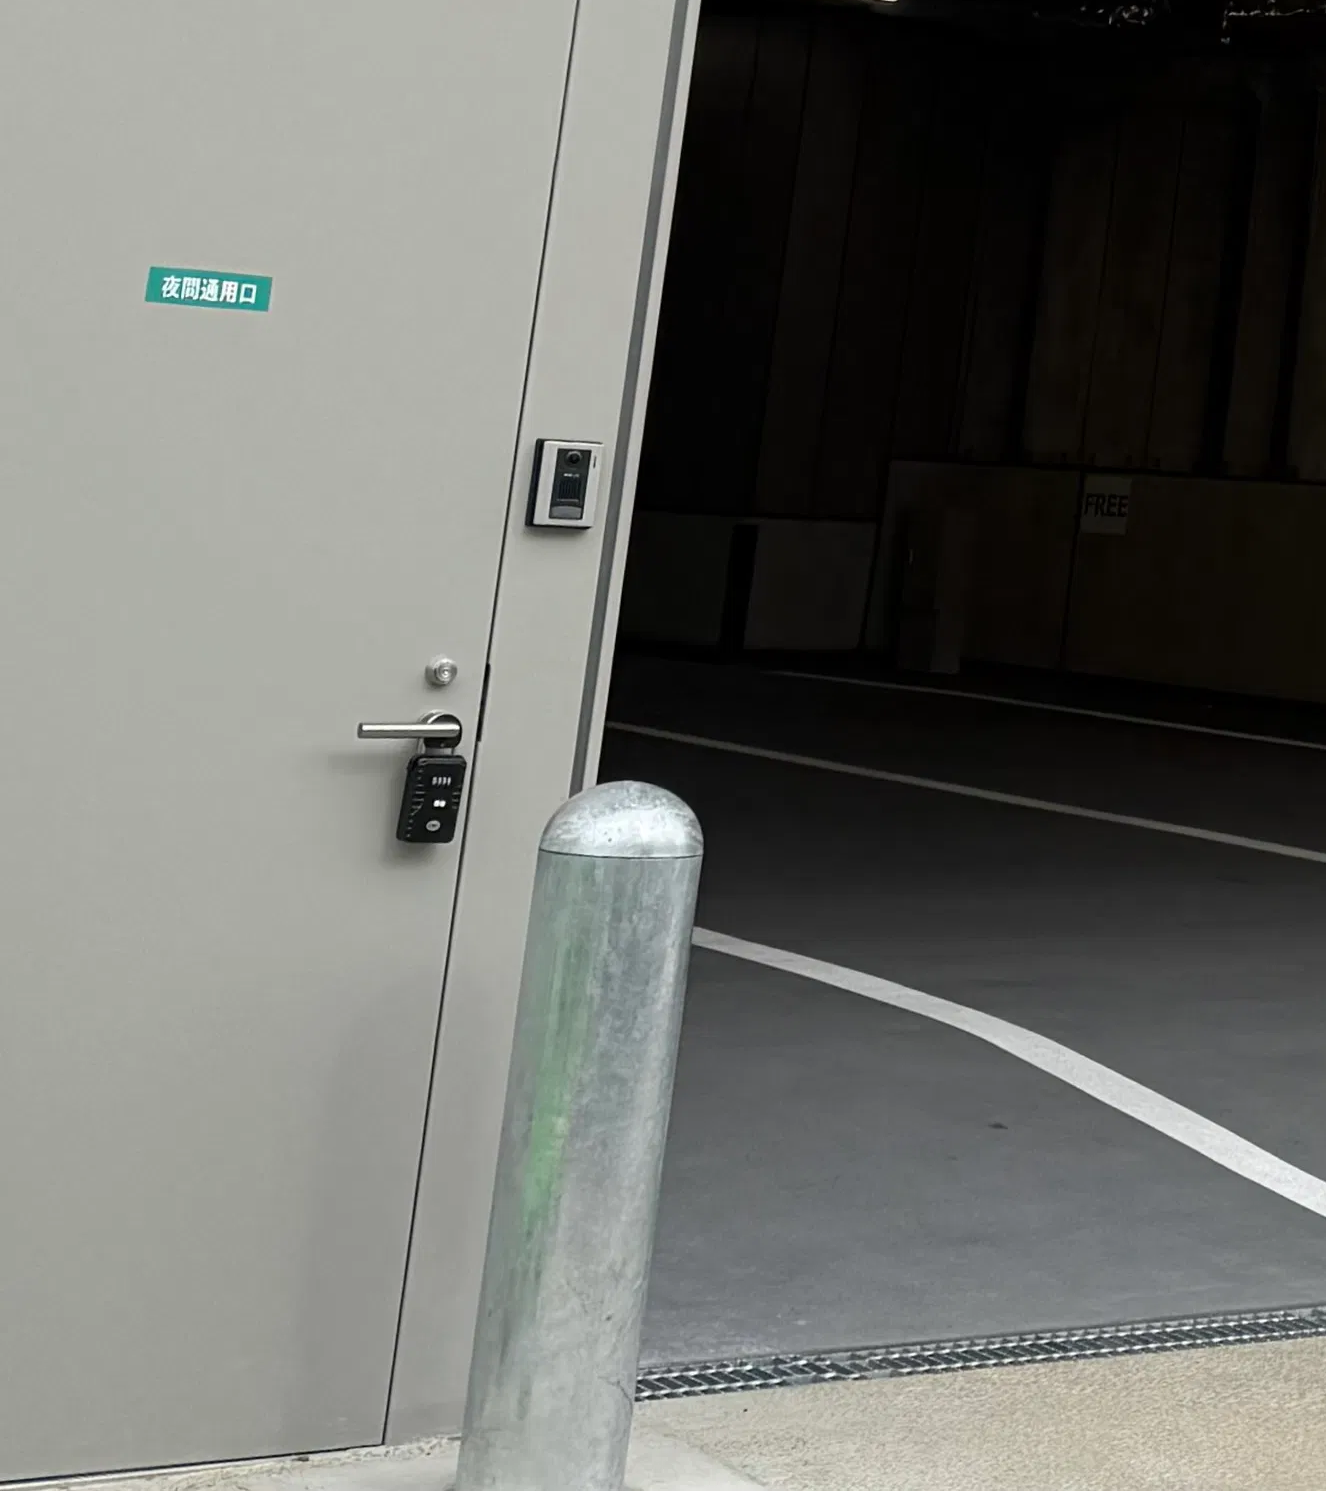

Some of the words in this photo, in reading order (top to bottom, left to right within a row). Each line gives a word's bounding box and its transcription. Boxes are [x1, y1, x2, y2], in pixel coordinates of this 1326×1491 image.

[161, 275, 257, 304] 夜間通用口
[1083, 492, 1129, 518] FREE
